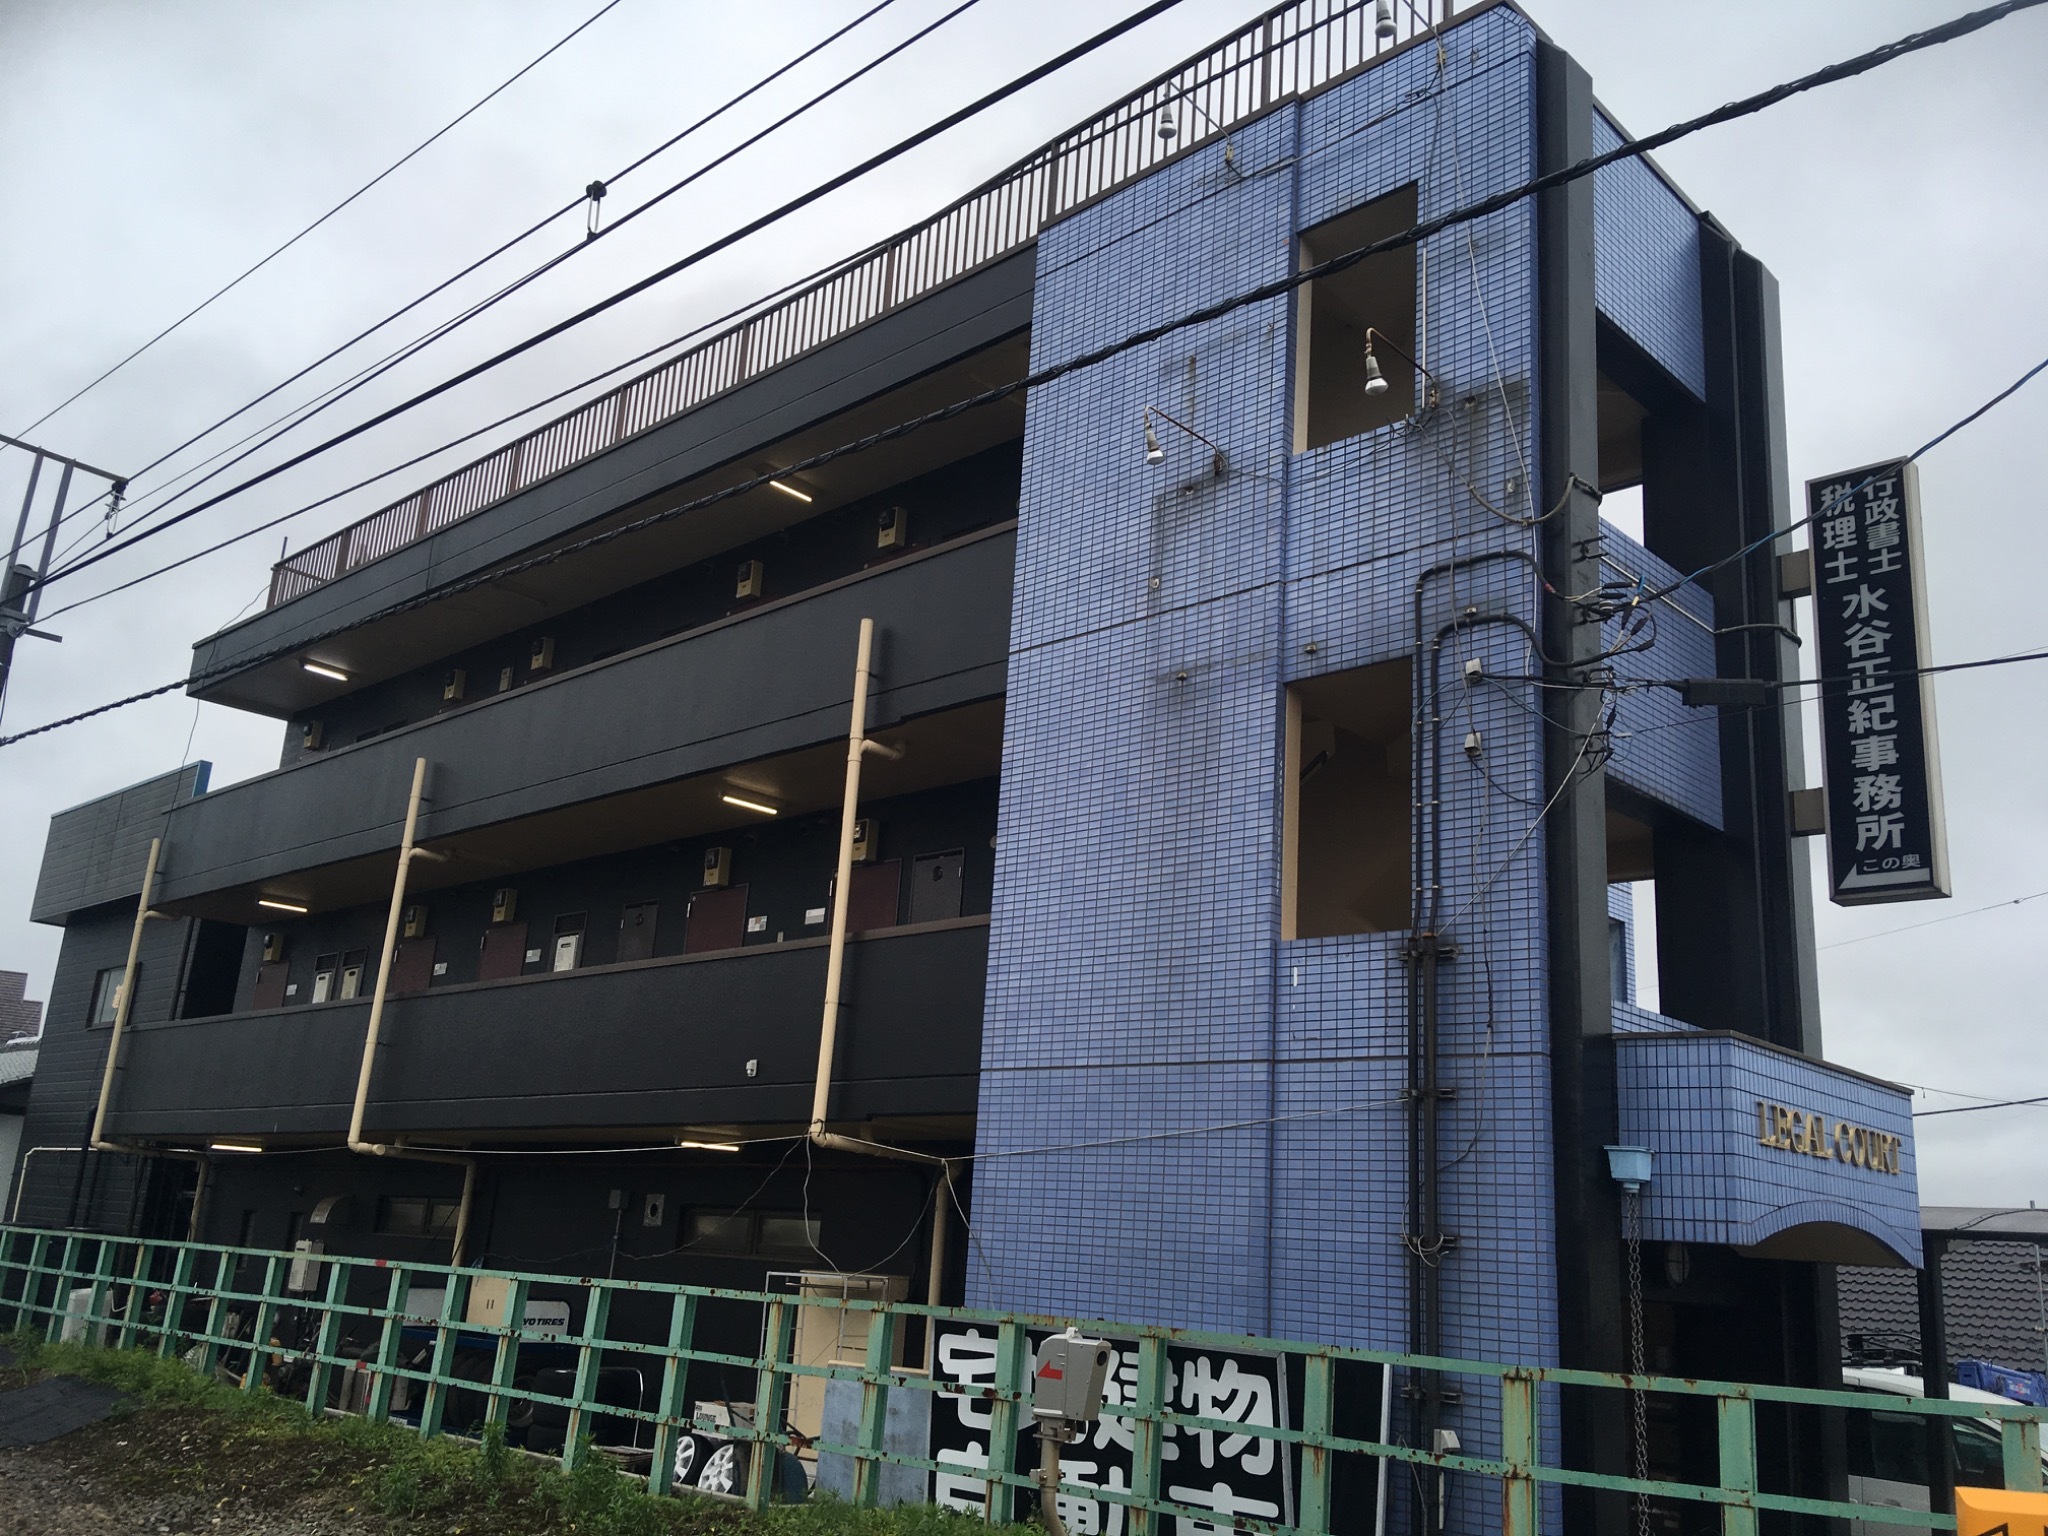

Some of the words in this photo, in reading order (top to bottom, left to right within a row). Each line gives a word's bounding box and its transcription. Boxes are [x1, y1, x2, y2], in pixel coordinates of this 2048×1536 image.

[1820, 481, 1859, 584] 税理士
[1863, 474, 1902, 575] 行政書士
[1842, 583, 1906, 851] 水谷正紀事務所
[1863, 854, 1921, 872] この奥
[1757, 1100, 1834, 1160] LEGAL
[1834, 1121, 1902, 1175] COURT
[537, 1318, 565, 1326] TIRES
[938, 1328, 1275, 1476] 宅建物
